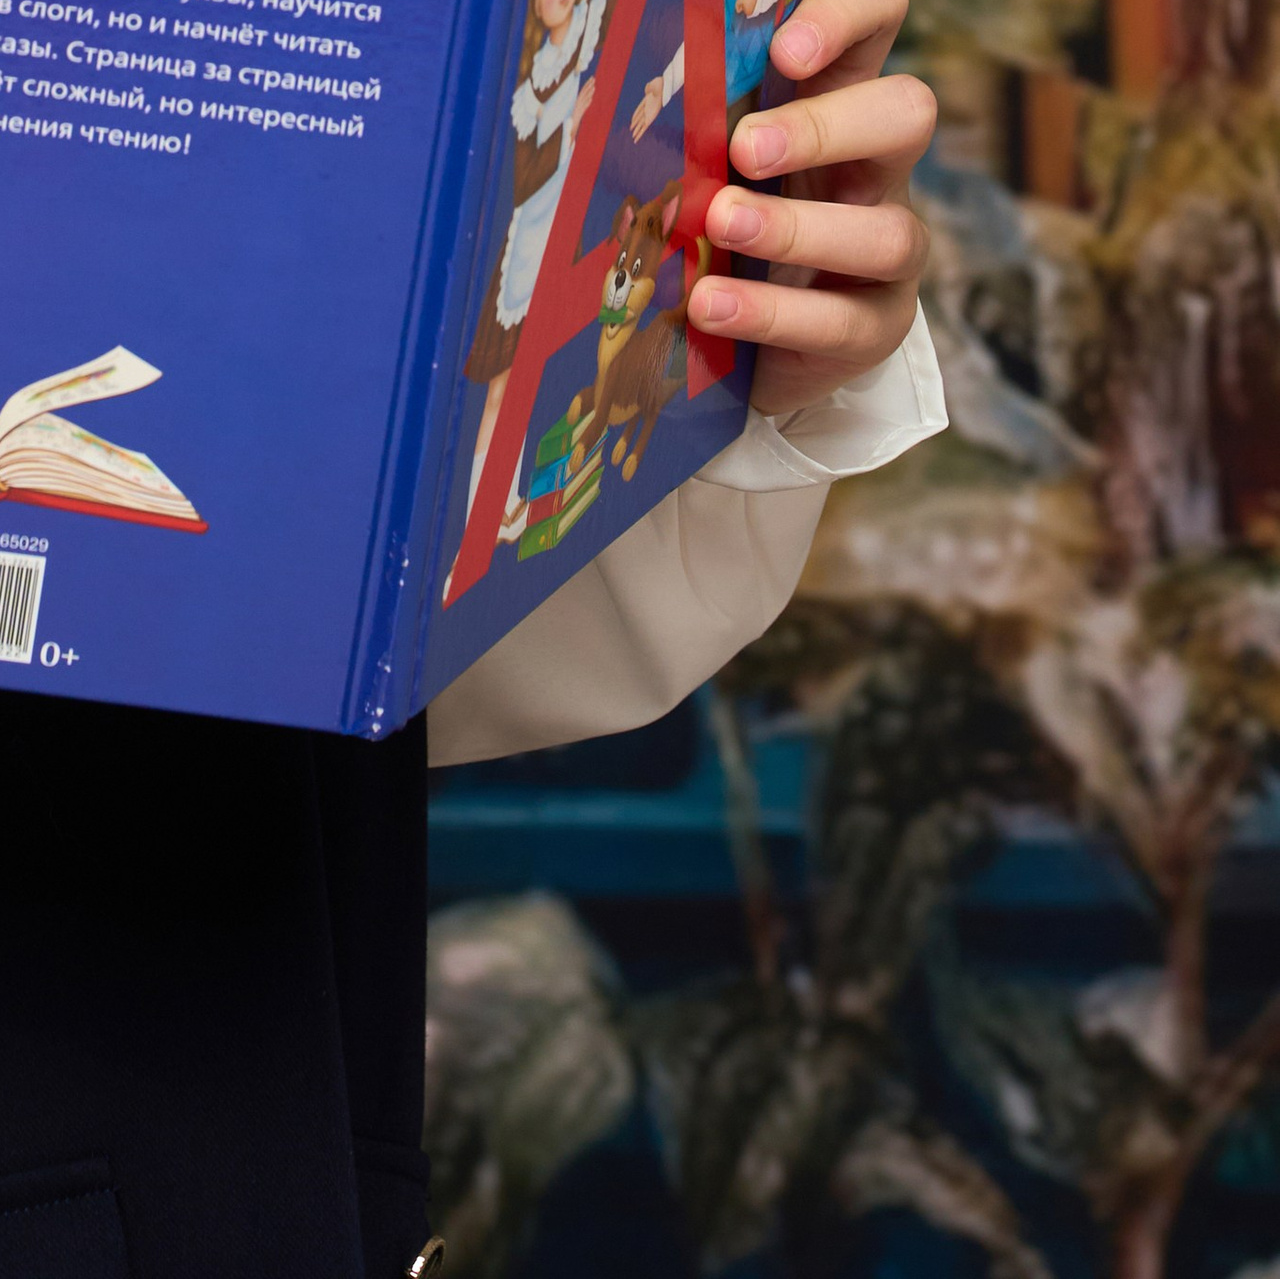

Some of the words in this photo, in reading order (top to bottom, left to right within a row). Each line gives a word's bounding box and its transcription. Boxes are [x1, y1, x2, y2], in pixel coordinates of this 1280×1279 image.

[18, 0, 100, 29] слоги,
[108, 10, 143, 31] но
[148, 16, 167, 34] и
[173, 19, 269, 47] начнёт
[273, 32, 362, 59] читать
[66, 40, 197, 79] Страница
[203, 62, 232, 82] за
[238, 67, 382, 101] страницей
[22, 78, 152, 114] сложный,
[159, 95, 194, 116] но
[200, 101, 365, 138] интересный
[79, 124, 192, 155] чтению!
[39, 641, 80, 667] 0+
